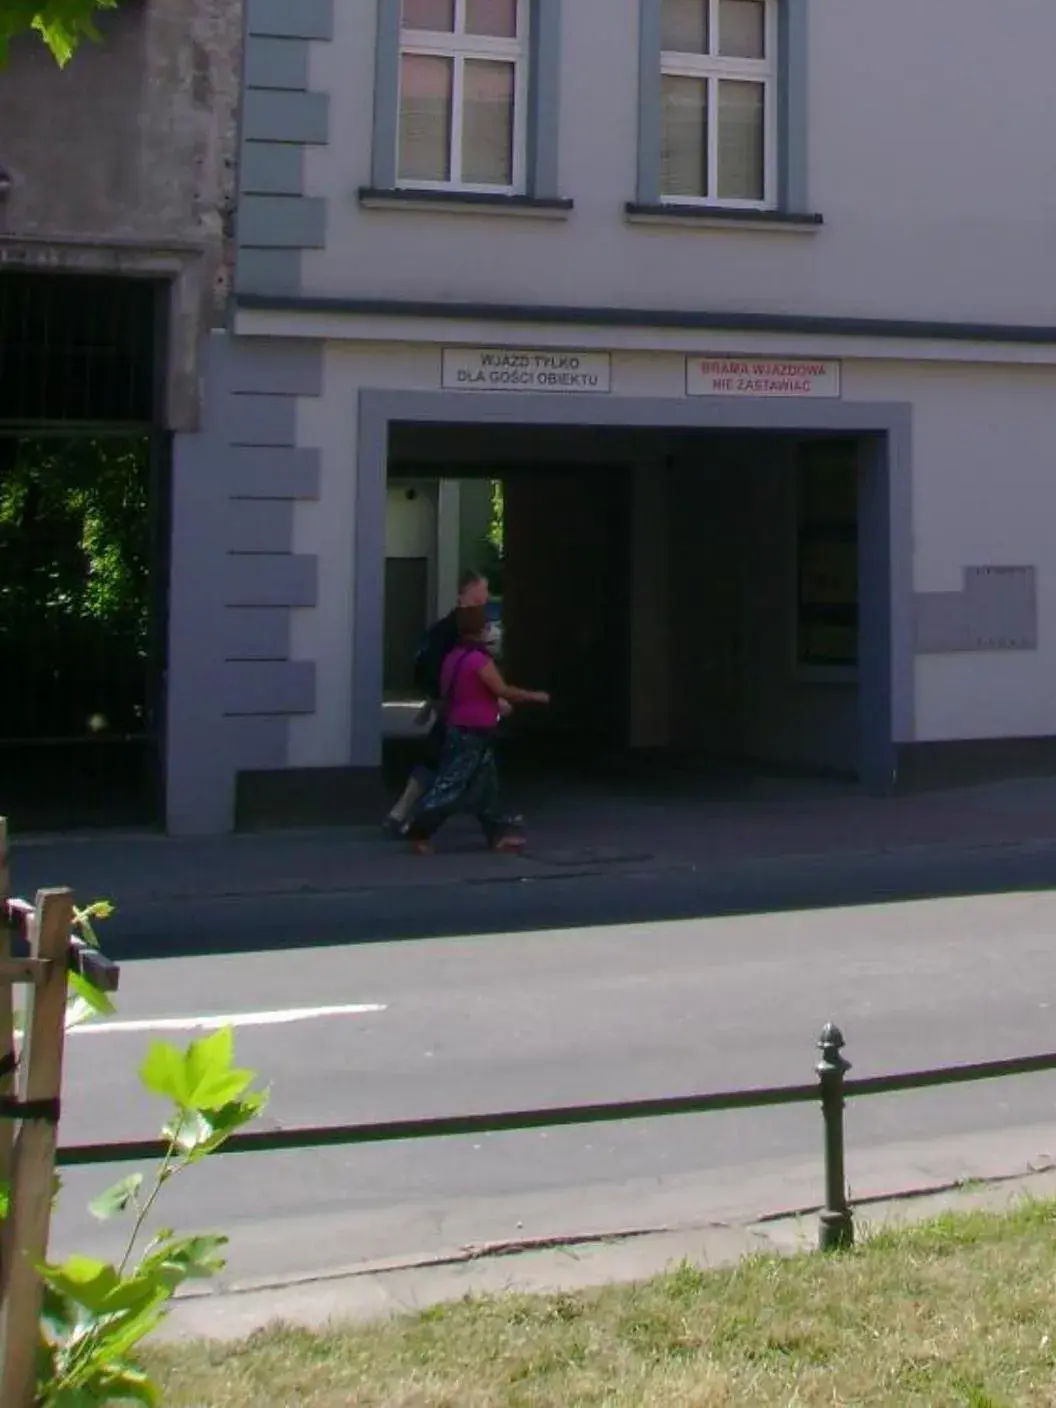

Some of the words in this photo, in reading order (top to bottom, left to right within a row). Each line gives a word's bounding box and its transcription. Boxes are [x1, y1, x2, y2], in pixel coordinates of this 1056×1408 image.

[536, 355, 579, 369] TYLKO
[457, 369, 486, 383] DLA
[538, 371, 598, 386] OBIEKTU
[713, 378, 732, 391] NIE
